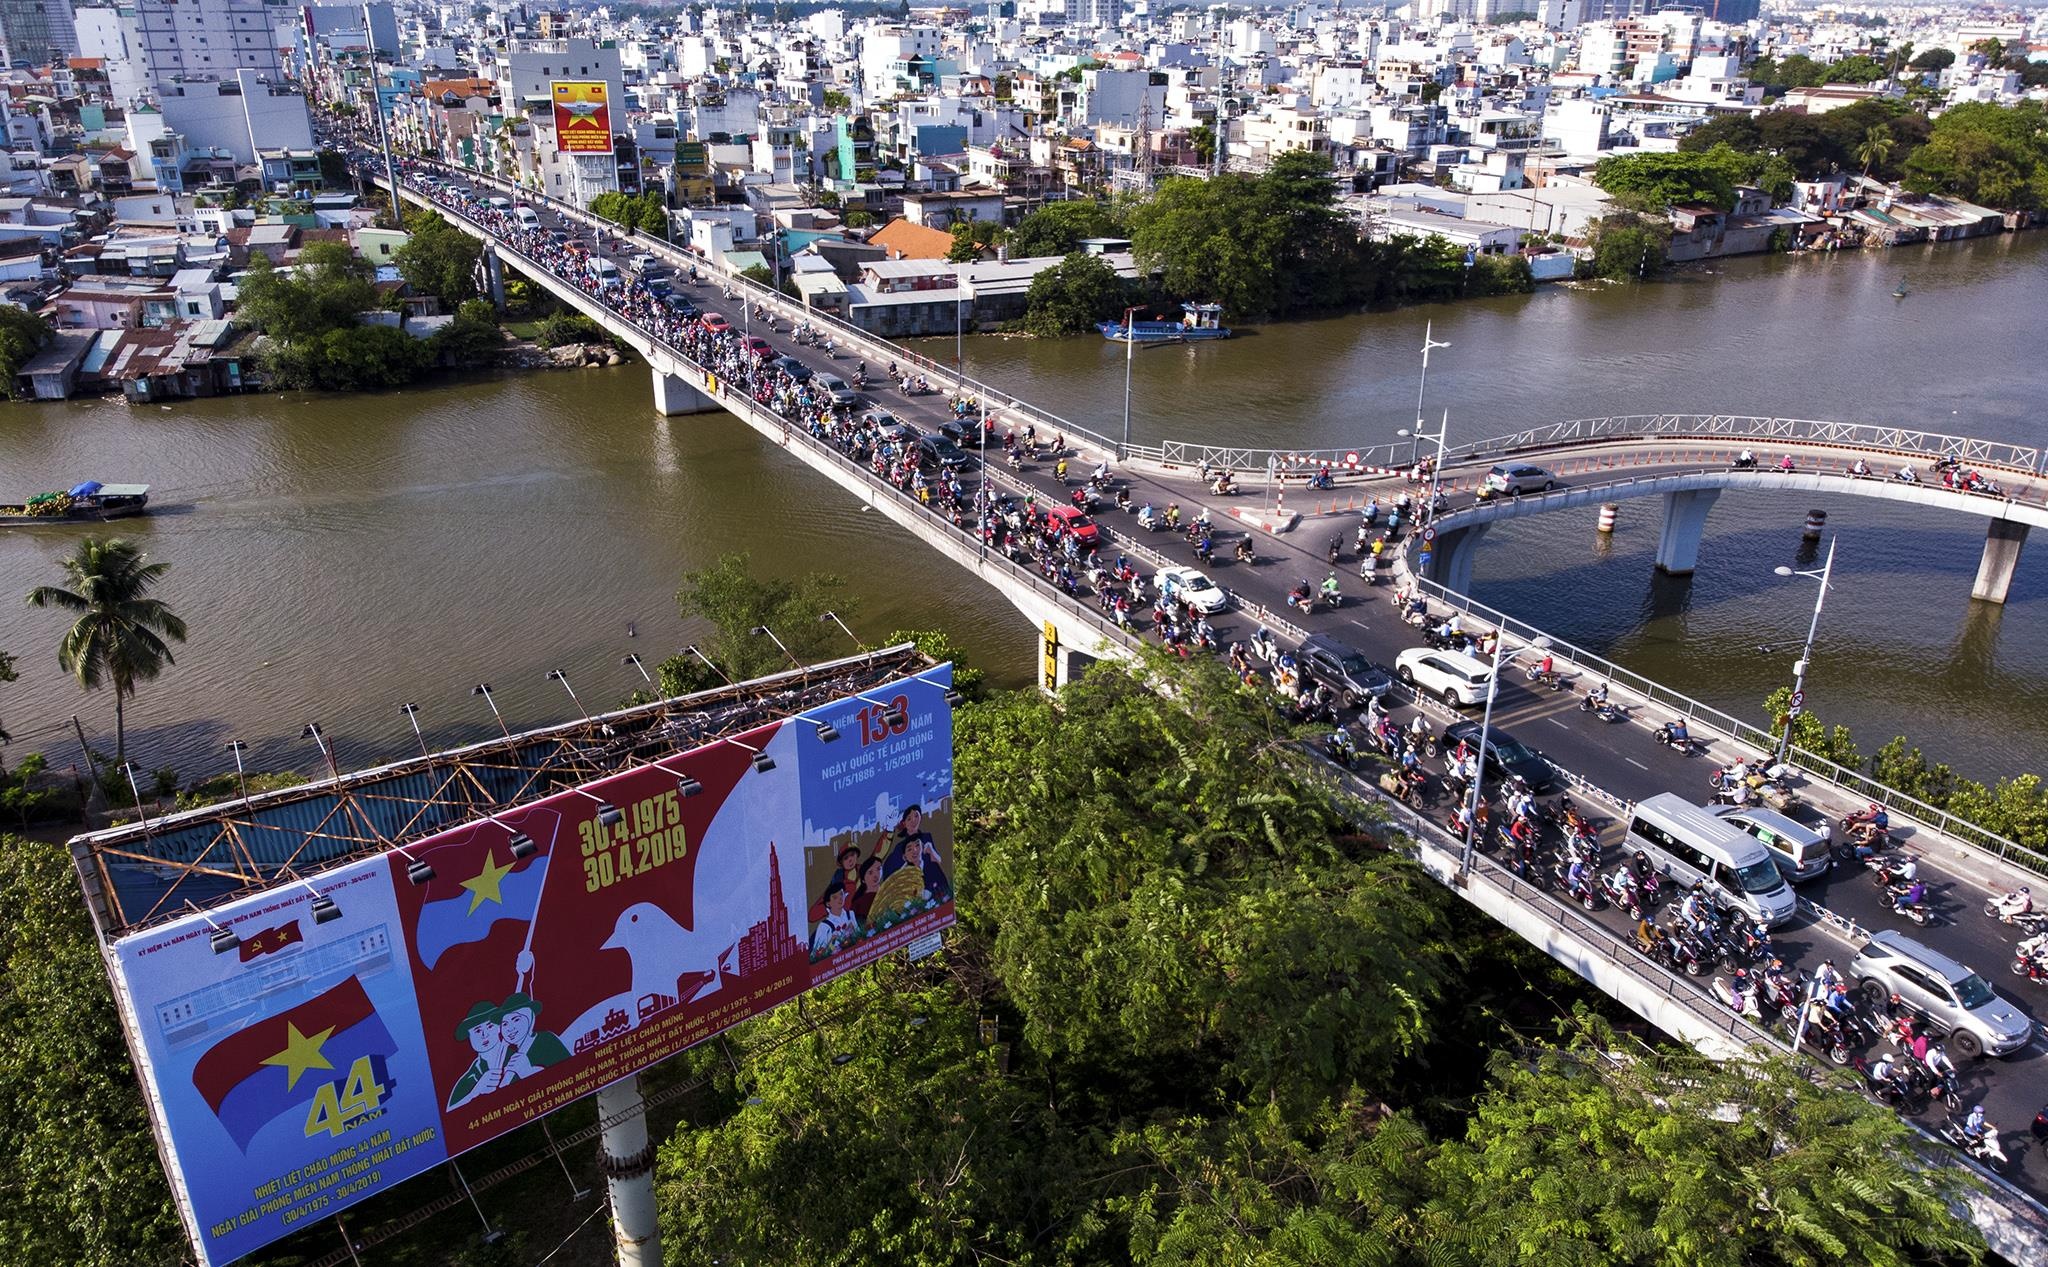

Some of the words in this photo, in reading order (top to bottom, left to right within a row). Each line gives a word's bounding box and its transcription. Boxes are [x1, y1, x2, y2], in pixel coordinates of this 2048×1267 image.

[822, 761, 847, 780] NGÀY
[850, 749, 874, 770] QUỐC
[878, 742, 888, 759] TẾ
[890, 740, 907, 754] LAO
[909, 730, 934, 748] ĐỘNG
[832, 713, 854, 730] NIỆM
[856, 694, 910, 748] 133
[910, 713, 932, 730] NĂM
[834, 766, 874, 792] (1/5/1886
[884, 749, 924, 772] 1/5/2019)
[578, 788, 680, 857] 30.4.1975
[583, 824, 687, 893] 30.4.2019
[186, 930, 200, 940] NGÀY
[249, 910, 262, 919] NAM
[468, 1119, 480, 1130] 44
[482, 1109, 502, 1124] NĂM
[503, 1097, 526, 1114] NGÀY
[528, 1088, 544, 1104] GIẢI
[546, 1076, 574, 1096] PHÓNG
[576, 1066, 596, 1081] MIỀN
[598, 1058, 618, 1072] NAM,
[619, 1044, 645, 1061] THỐNG
[646, 1033, 667, 1049] NHẤT
[668, 1024, 685, 1038] ĐẤT
[686, 1014, 705, 1031] NƯỚC
[707, 996, 748, 1021] (30/4/1975
[754, 976, 792, 1000] 30/4/2019)
[524, 1108, 535, 1120] VÀ
[538, 1100, 552, 1113] 133
[554, 1090, 573, 1105] NĂM
[575, 1079, 596, 1096] NGÀY
[598, 1066, 619, 1085] QUỐC
[621, 1062, 632, 1074] TẾ
[632, 1056, 648, 1070] LAO
[649, 1044, 670, 1060] ĐỘNG
[672, 1026, 709, 1051] (1/5/1886
[716, 1007, 752, 1030] 1/5/2019)
[595, 1042, 618, 1059] NHIỆT
[620, 1033, 637, 1048] LIỆT
[640, 1024, 660, 1039] CHÀO
[662, 1012, 684, 1029] MỪNG
[304, 1054, 385, 1138] 44
[211, 1215, 238, 1239] NGÀY
[239, 1206, 260, 1227] GIẢI
[260, 1191, 292, 1217] PHÓNG
[294, 1180, 318, 1202] MIỀN
[318, 1171, 340, 1192] NAM
[342, 1158, 370, 1180] THỐNG
[371, 1145, 394, 1166] NHẤT
[394, 1137, 411, 1155] ĐẤT
[412, 1126, 436, 1148] NƯỚC
[254, 1178, 282, 1200] NHIỆT
[284, 1168, 302, 1188] LIỆT
[303, 1156, 328, 1178] CHÀO
[330, 1146, 357, 1167] MỪNG
[358, 1140, 369, 1154] 44
[370, 1129, 392, 1148] NĂM
[282, 1194, 328, 1226] (30/4/1975
[336, 1170, 382, 1200] 30/4/2019)
